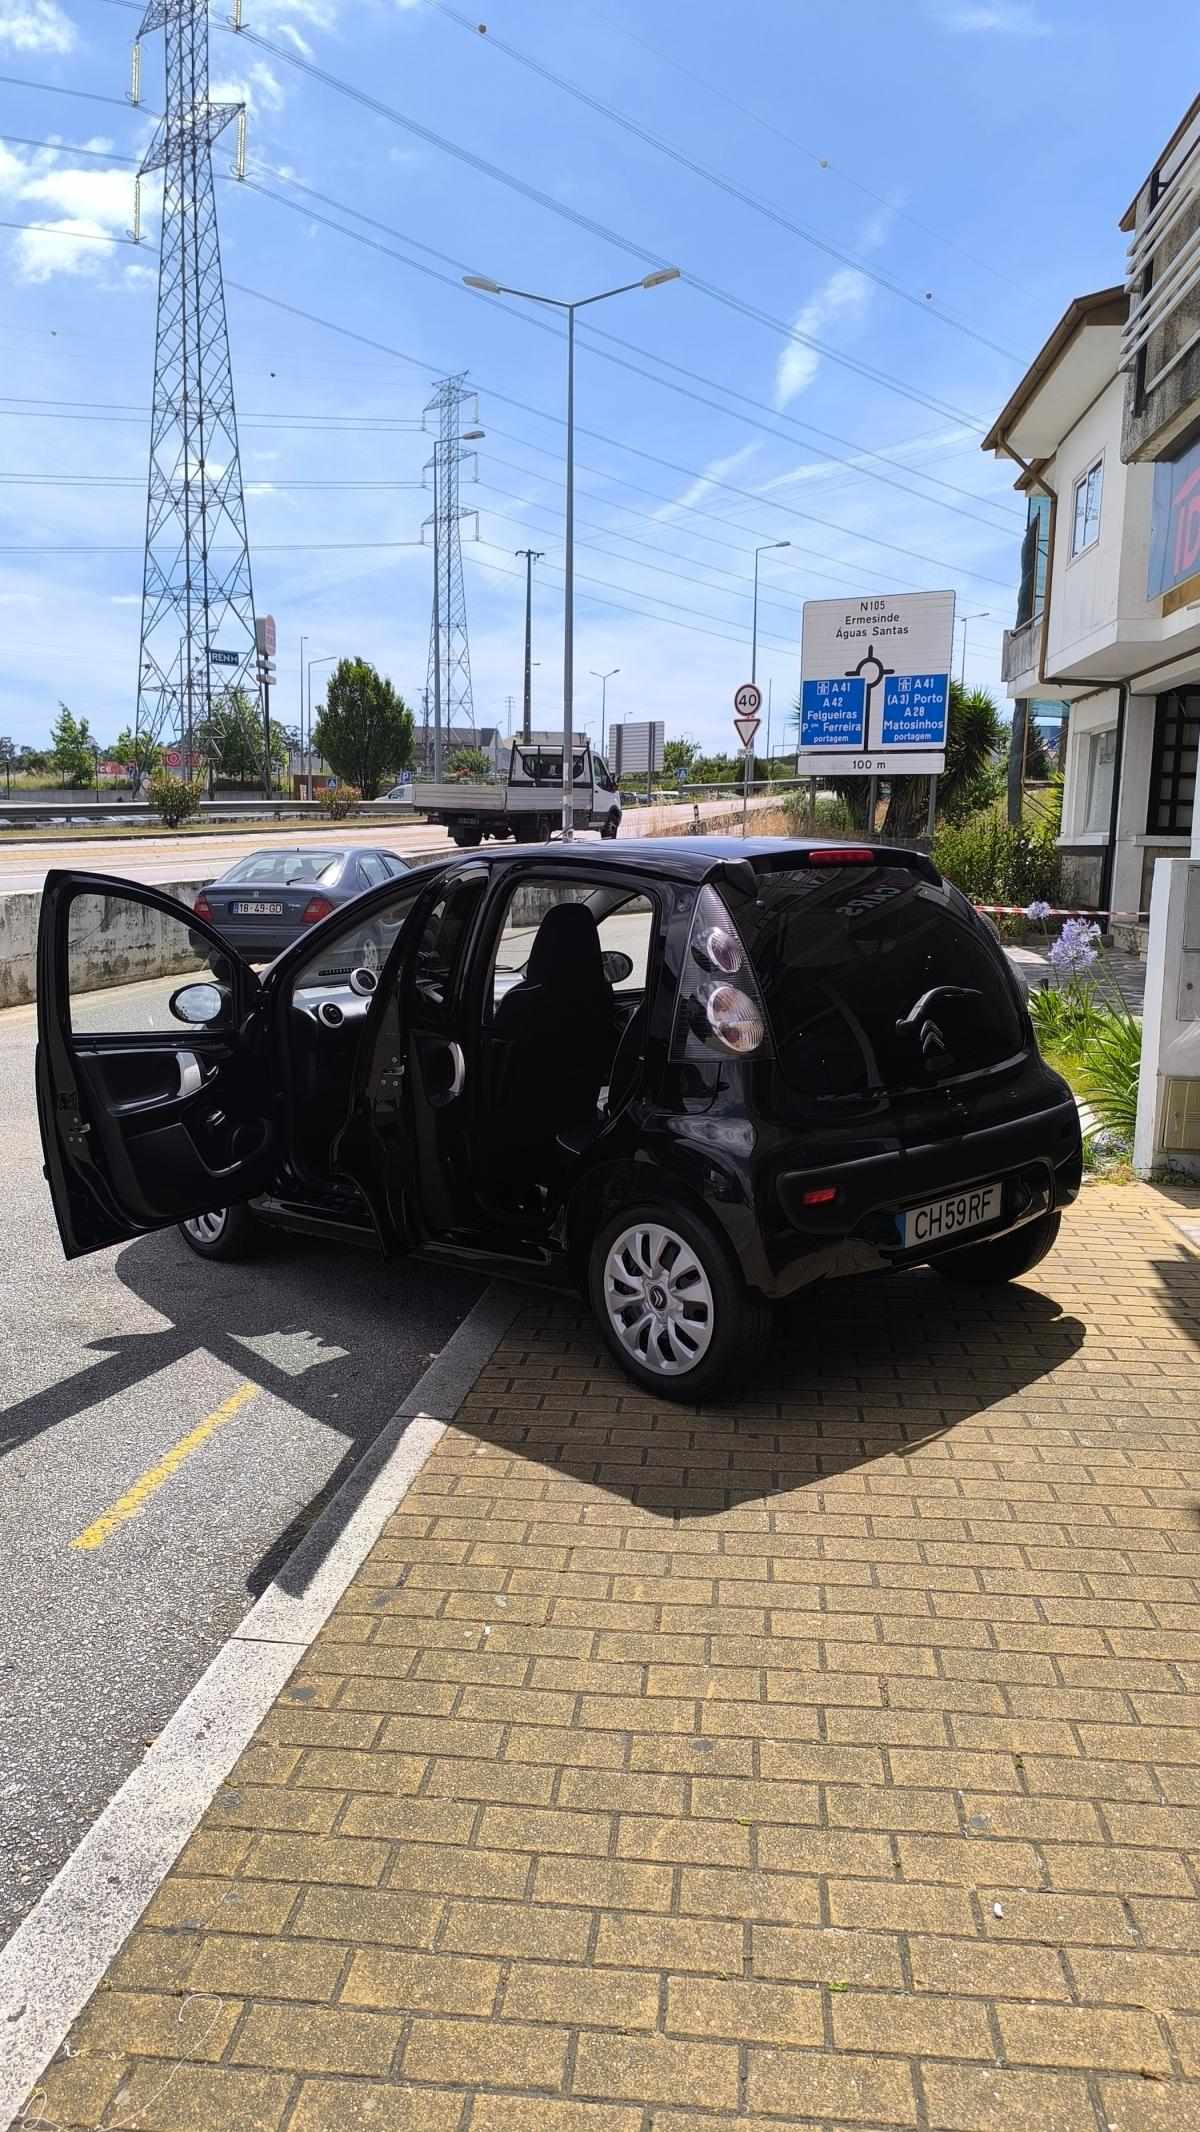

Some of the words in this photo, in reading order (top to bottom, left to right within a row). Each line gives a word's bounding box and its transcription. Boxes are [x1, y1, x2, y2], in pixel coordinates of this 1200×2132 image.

[861, 600, 886, 612] N105
[845, 613, 900, 625] Ermesinde
[836, 626, 867, 640] Águas
[872, 626, 909, 636] Santas
[739, 694, 757, 706] 40
[913, 693, 943, 704] Porto
[807, 710, 857, 721] Felgueiras
[823, 722, 862, 732] Ferreira
[884, 720, 944, 730] Matosinhos
[813, 735, 849, 743] portagem
[894, 733, 931, 742] portagem
[853, 760, 872, 769] 100
